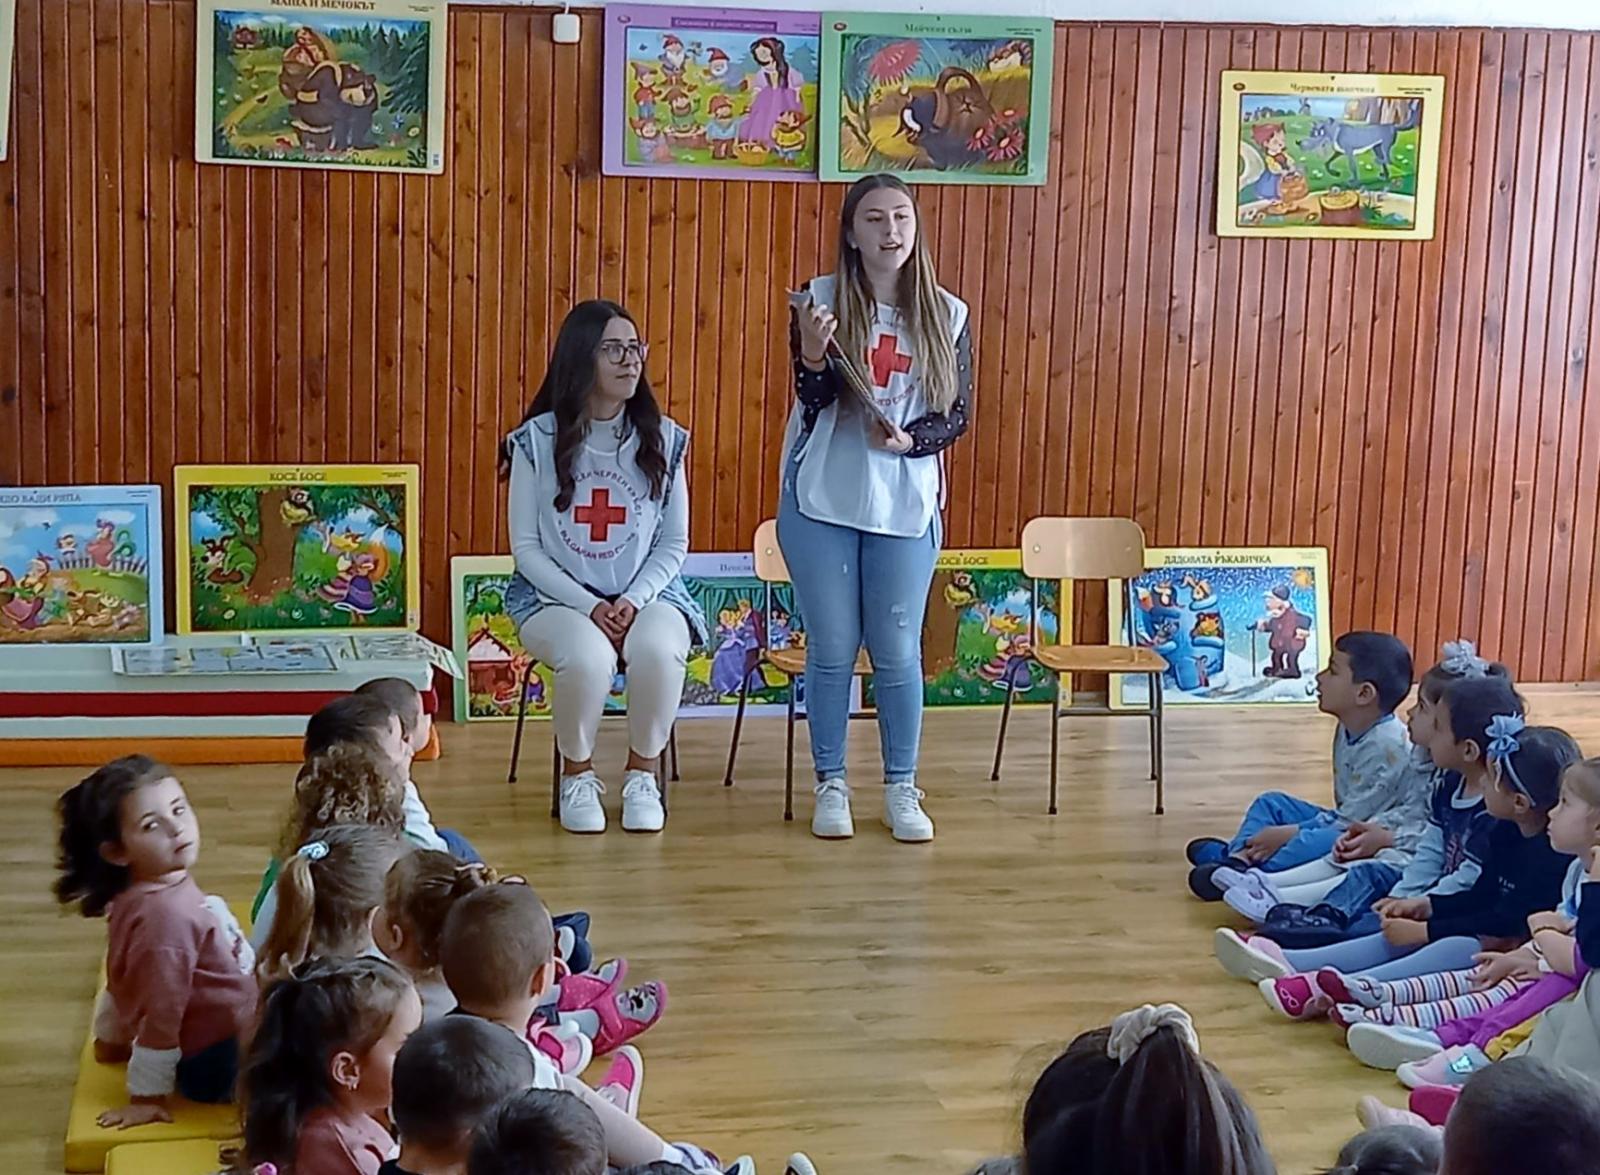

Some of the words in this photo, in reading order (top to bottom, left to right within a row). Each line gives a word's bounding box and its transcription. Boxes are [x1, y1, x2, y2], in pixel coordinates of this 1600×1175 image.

[320, 0, 376, 11] МЕЧОКЪТ
[598, 549, 615, 559] RED
[1163, 555, 1213, 565] ДЯДОВАТА
[1214, 555, 1272, 565] РЪКАВИЧКА
